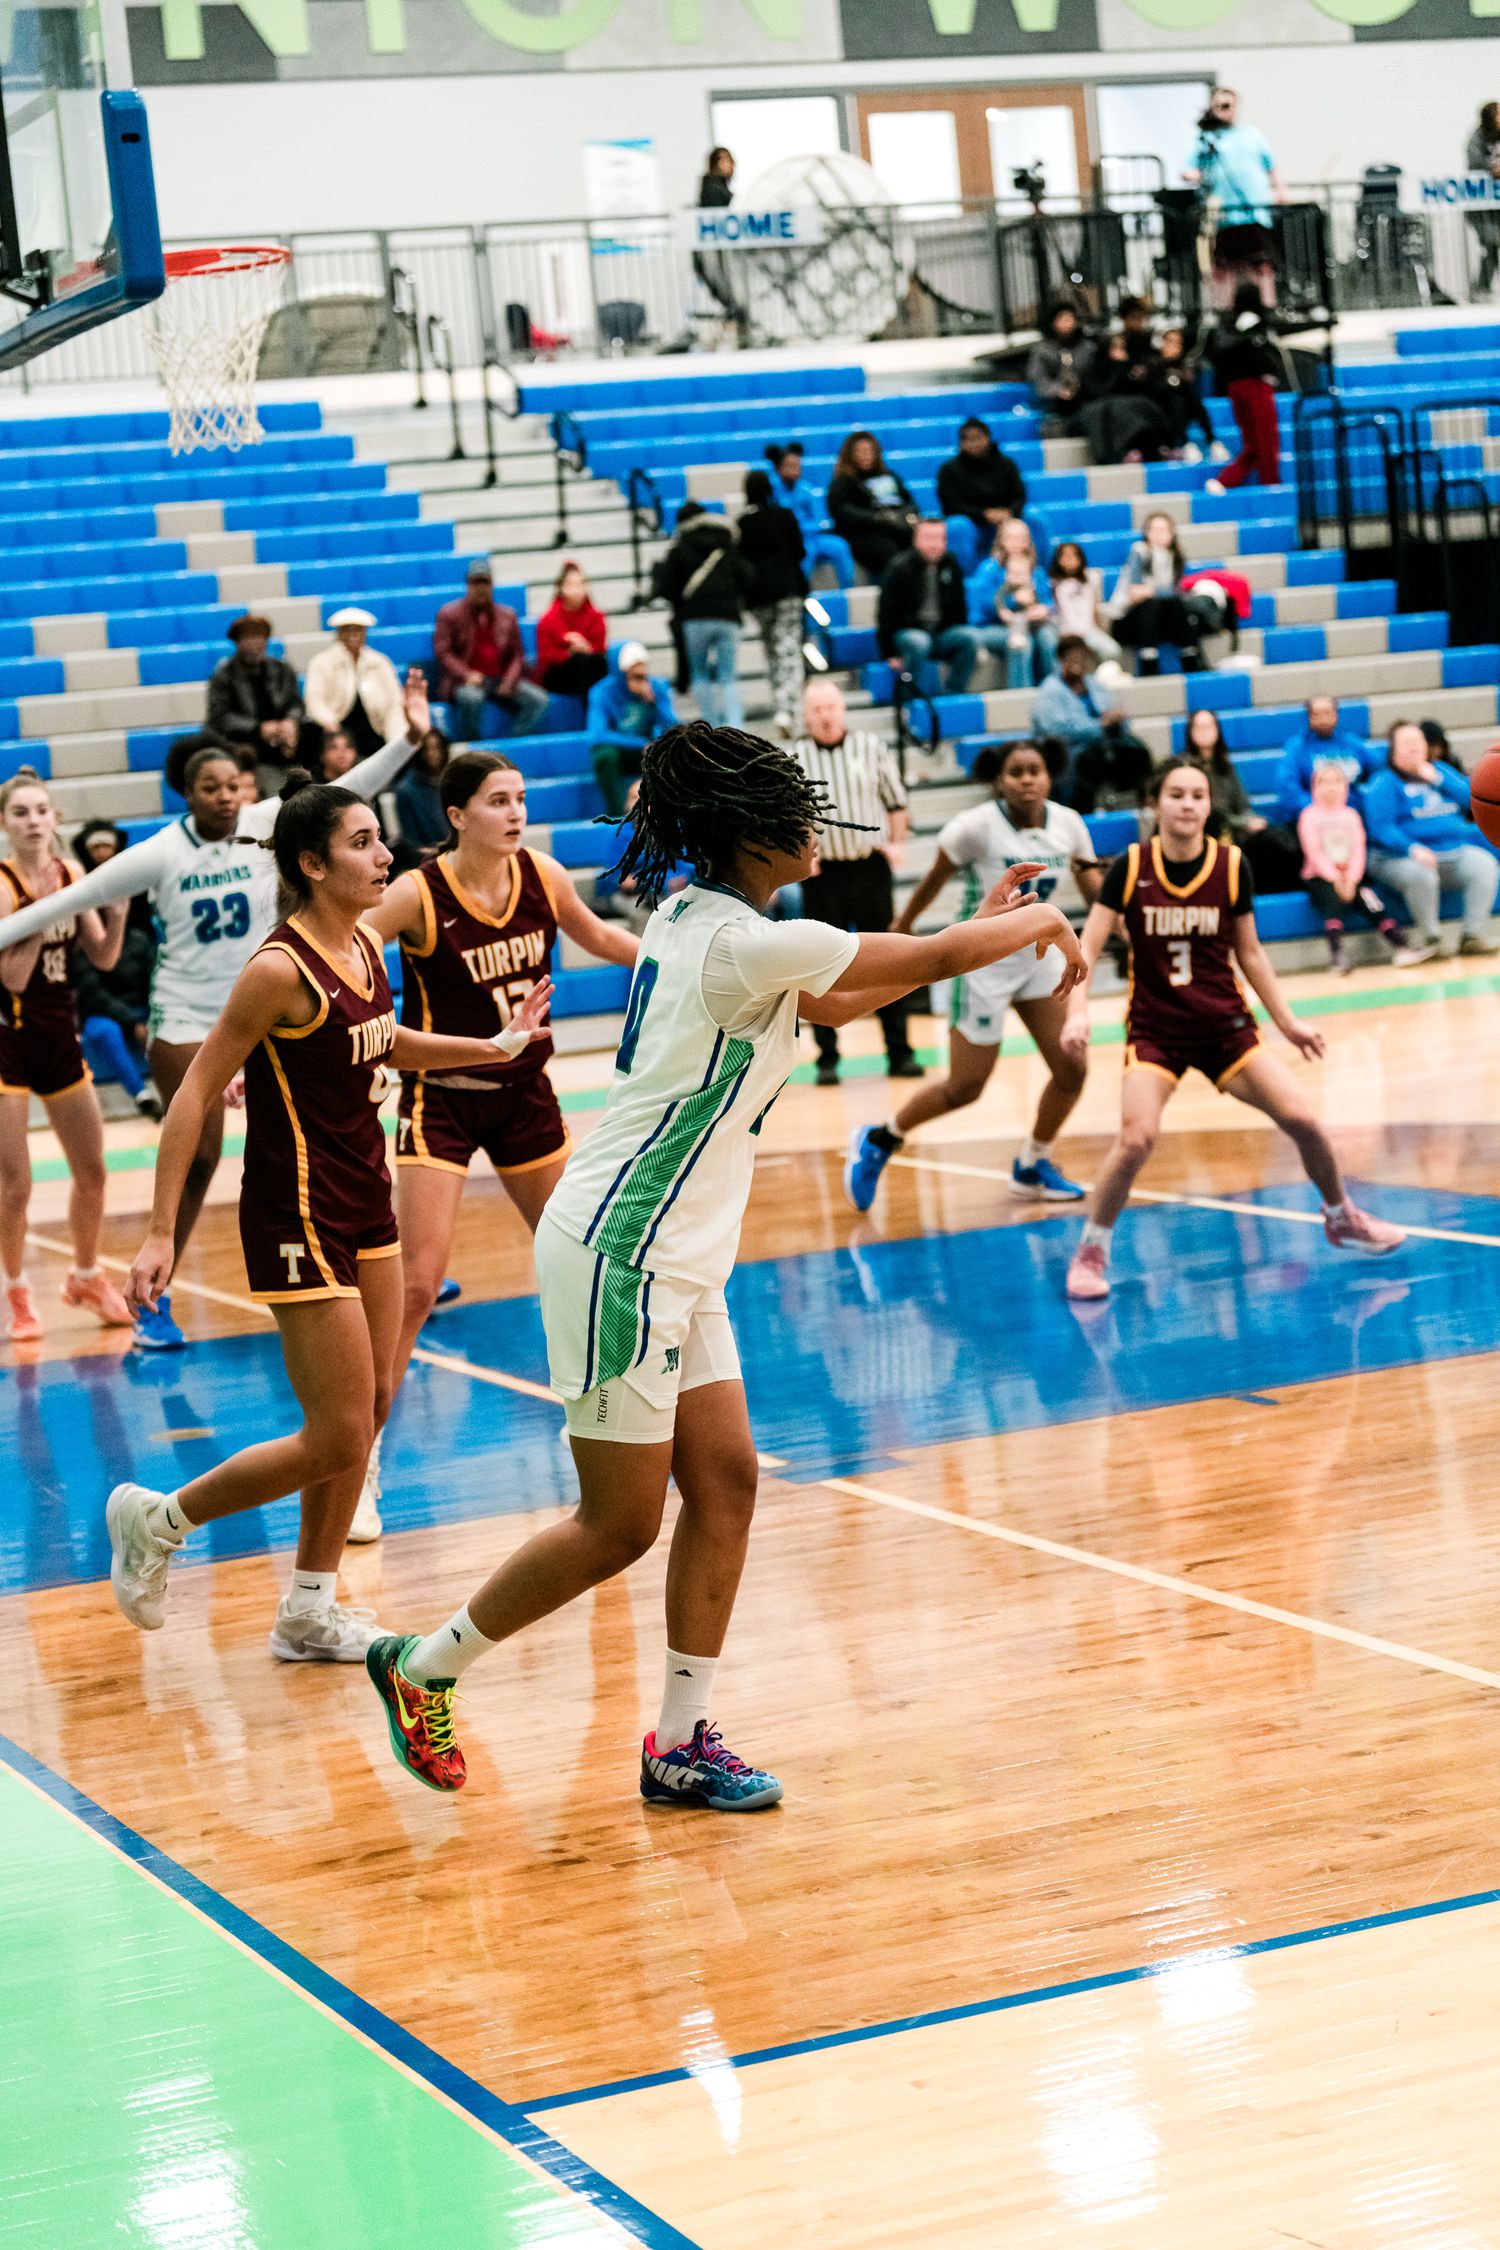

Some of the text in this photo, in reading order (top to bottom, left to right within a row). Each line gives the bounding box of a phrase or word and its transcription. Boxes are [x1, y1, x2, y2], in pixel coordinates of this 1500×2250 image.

[698, 211, 796, 241] HOME
[191, 891, 250, 945] 23
[1142, 905, 1220, 936] TURPIN
[460, 929, 546, 984] TURPIN
[1166, 940, 1193, 987] 3
[279, 1243, 305, 1284] T
[596, 1387, 609, 1424] TECHFIT
